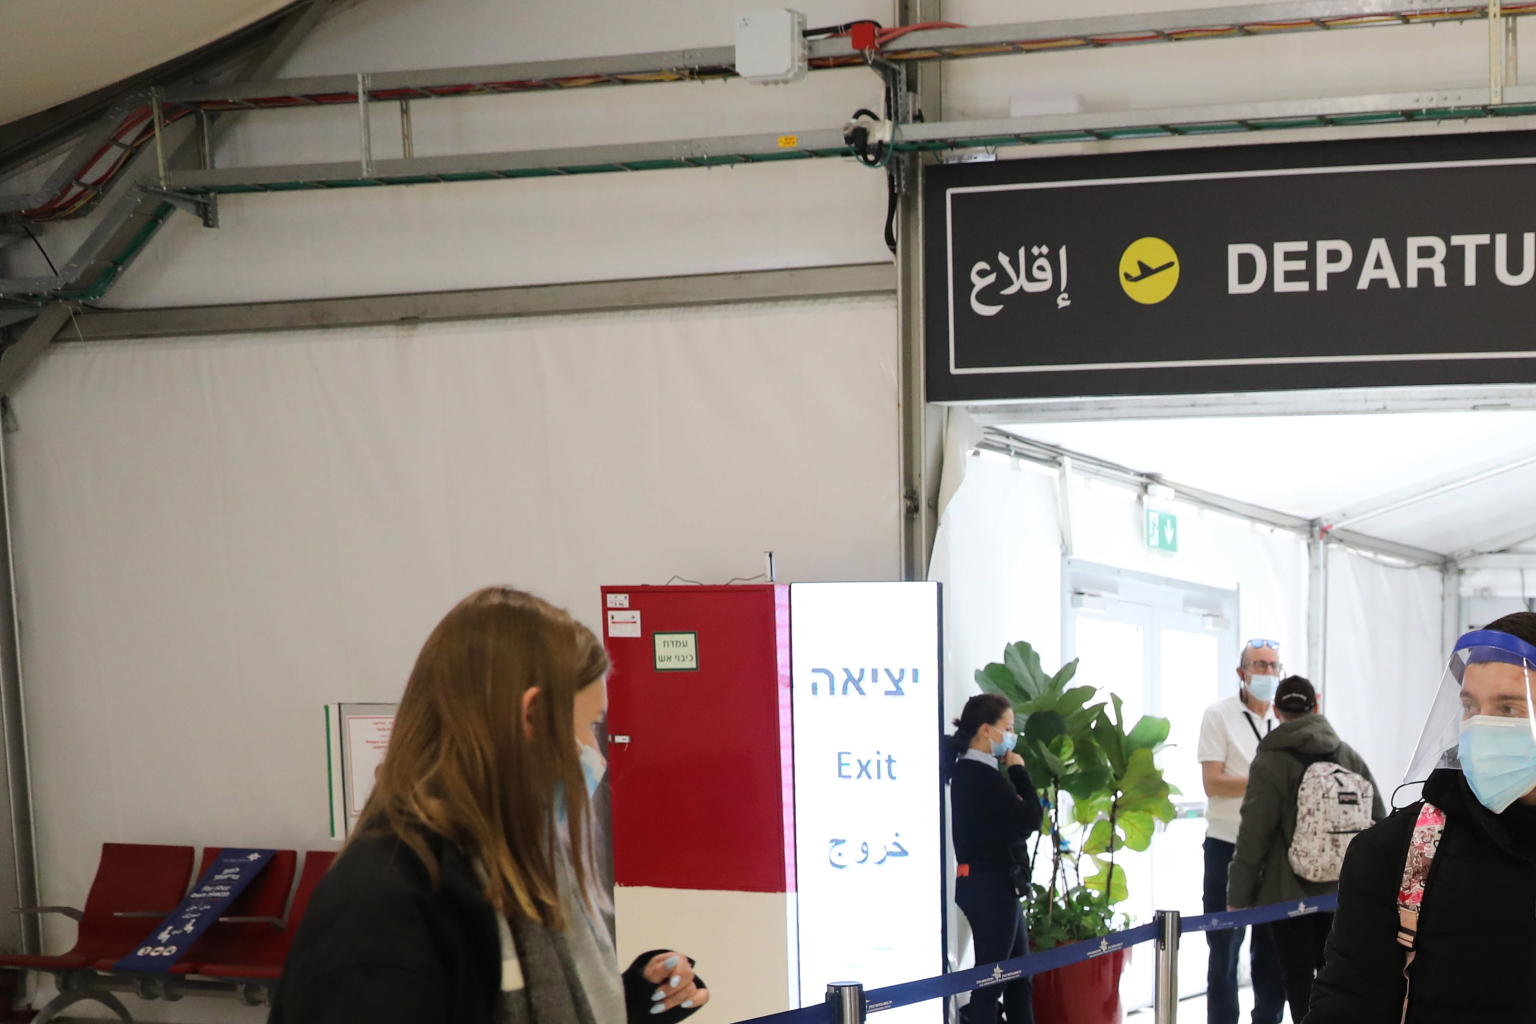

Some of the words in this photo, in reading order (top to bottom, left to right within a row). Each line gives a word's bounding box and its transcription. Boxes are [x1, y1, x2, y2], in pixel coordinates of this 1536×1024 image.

[969, 244, 1071, 317] إقلاع
[663, 640, 688, 648] עמדת
[675, 654, 694, 663] כיבוי
[658, 655, 673, 663] אש
[811, 667, 919, 696] יציאה
[837, 751, 897, 780] Exit
[828, 832, 909, 870] خروج
